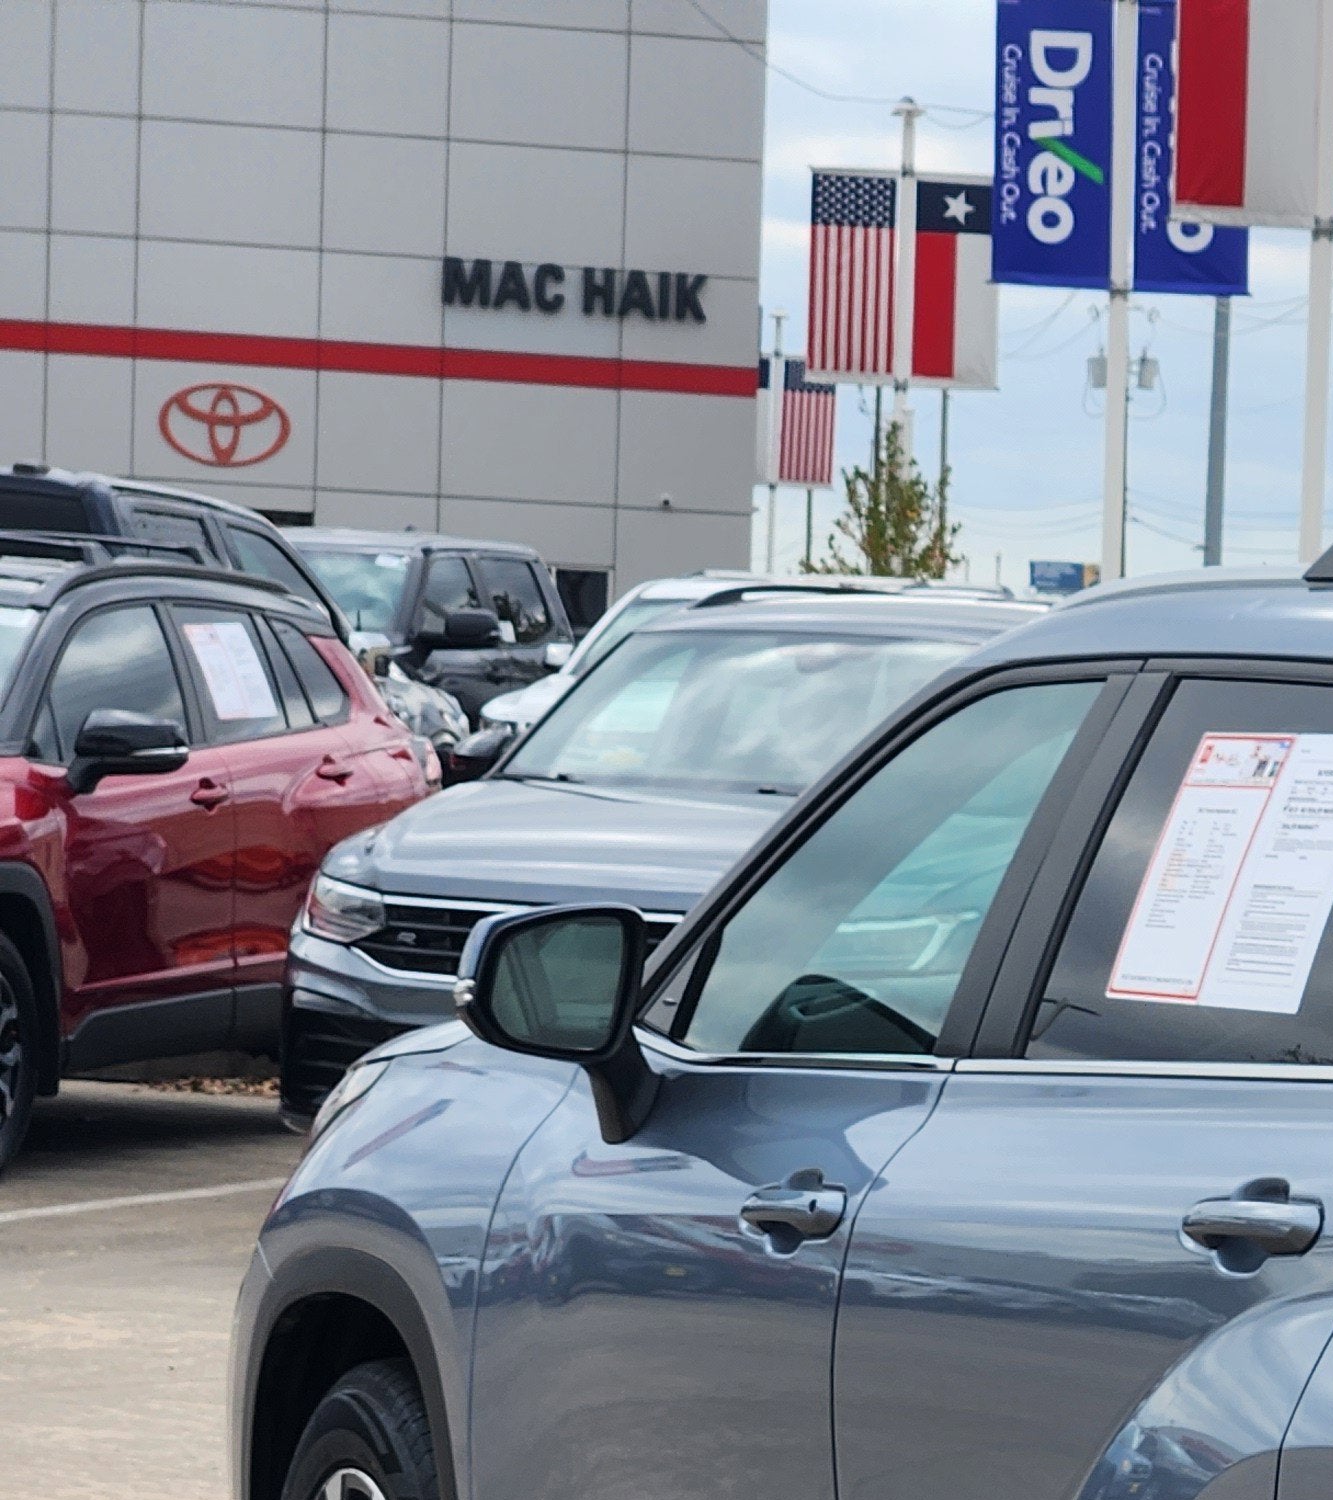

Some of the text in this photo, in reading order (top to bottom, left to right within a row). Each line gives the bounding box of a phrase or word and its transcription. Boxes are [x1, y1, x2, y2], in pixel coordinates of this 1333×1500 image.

[1001, 44, 1022, 104] Cruise
[1143, 53, 1163, 114] Cruise
[1001, 131, 1022, 179] Cash
[1142, 141, 1162, 188] Cash
[442, 256, 709, 324] MAC HAIK
